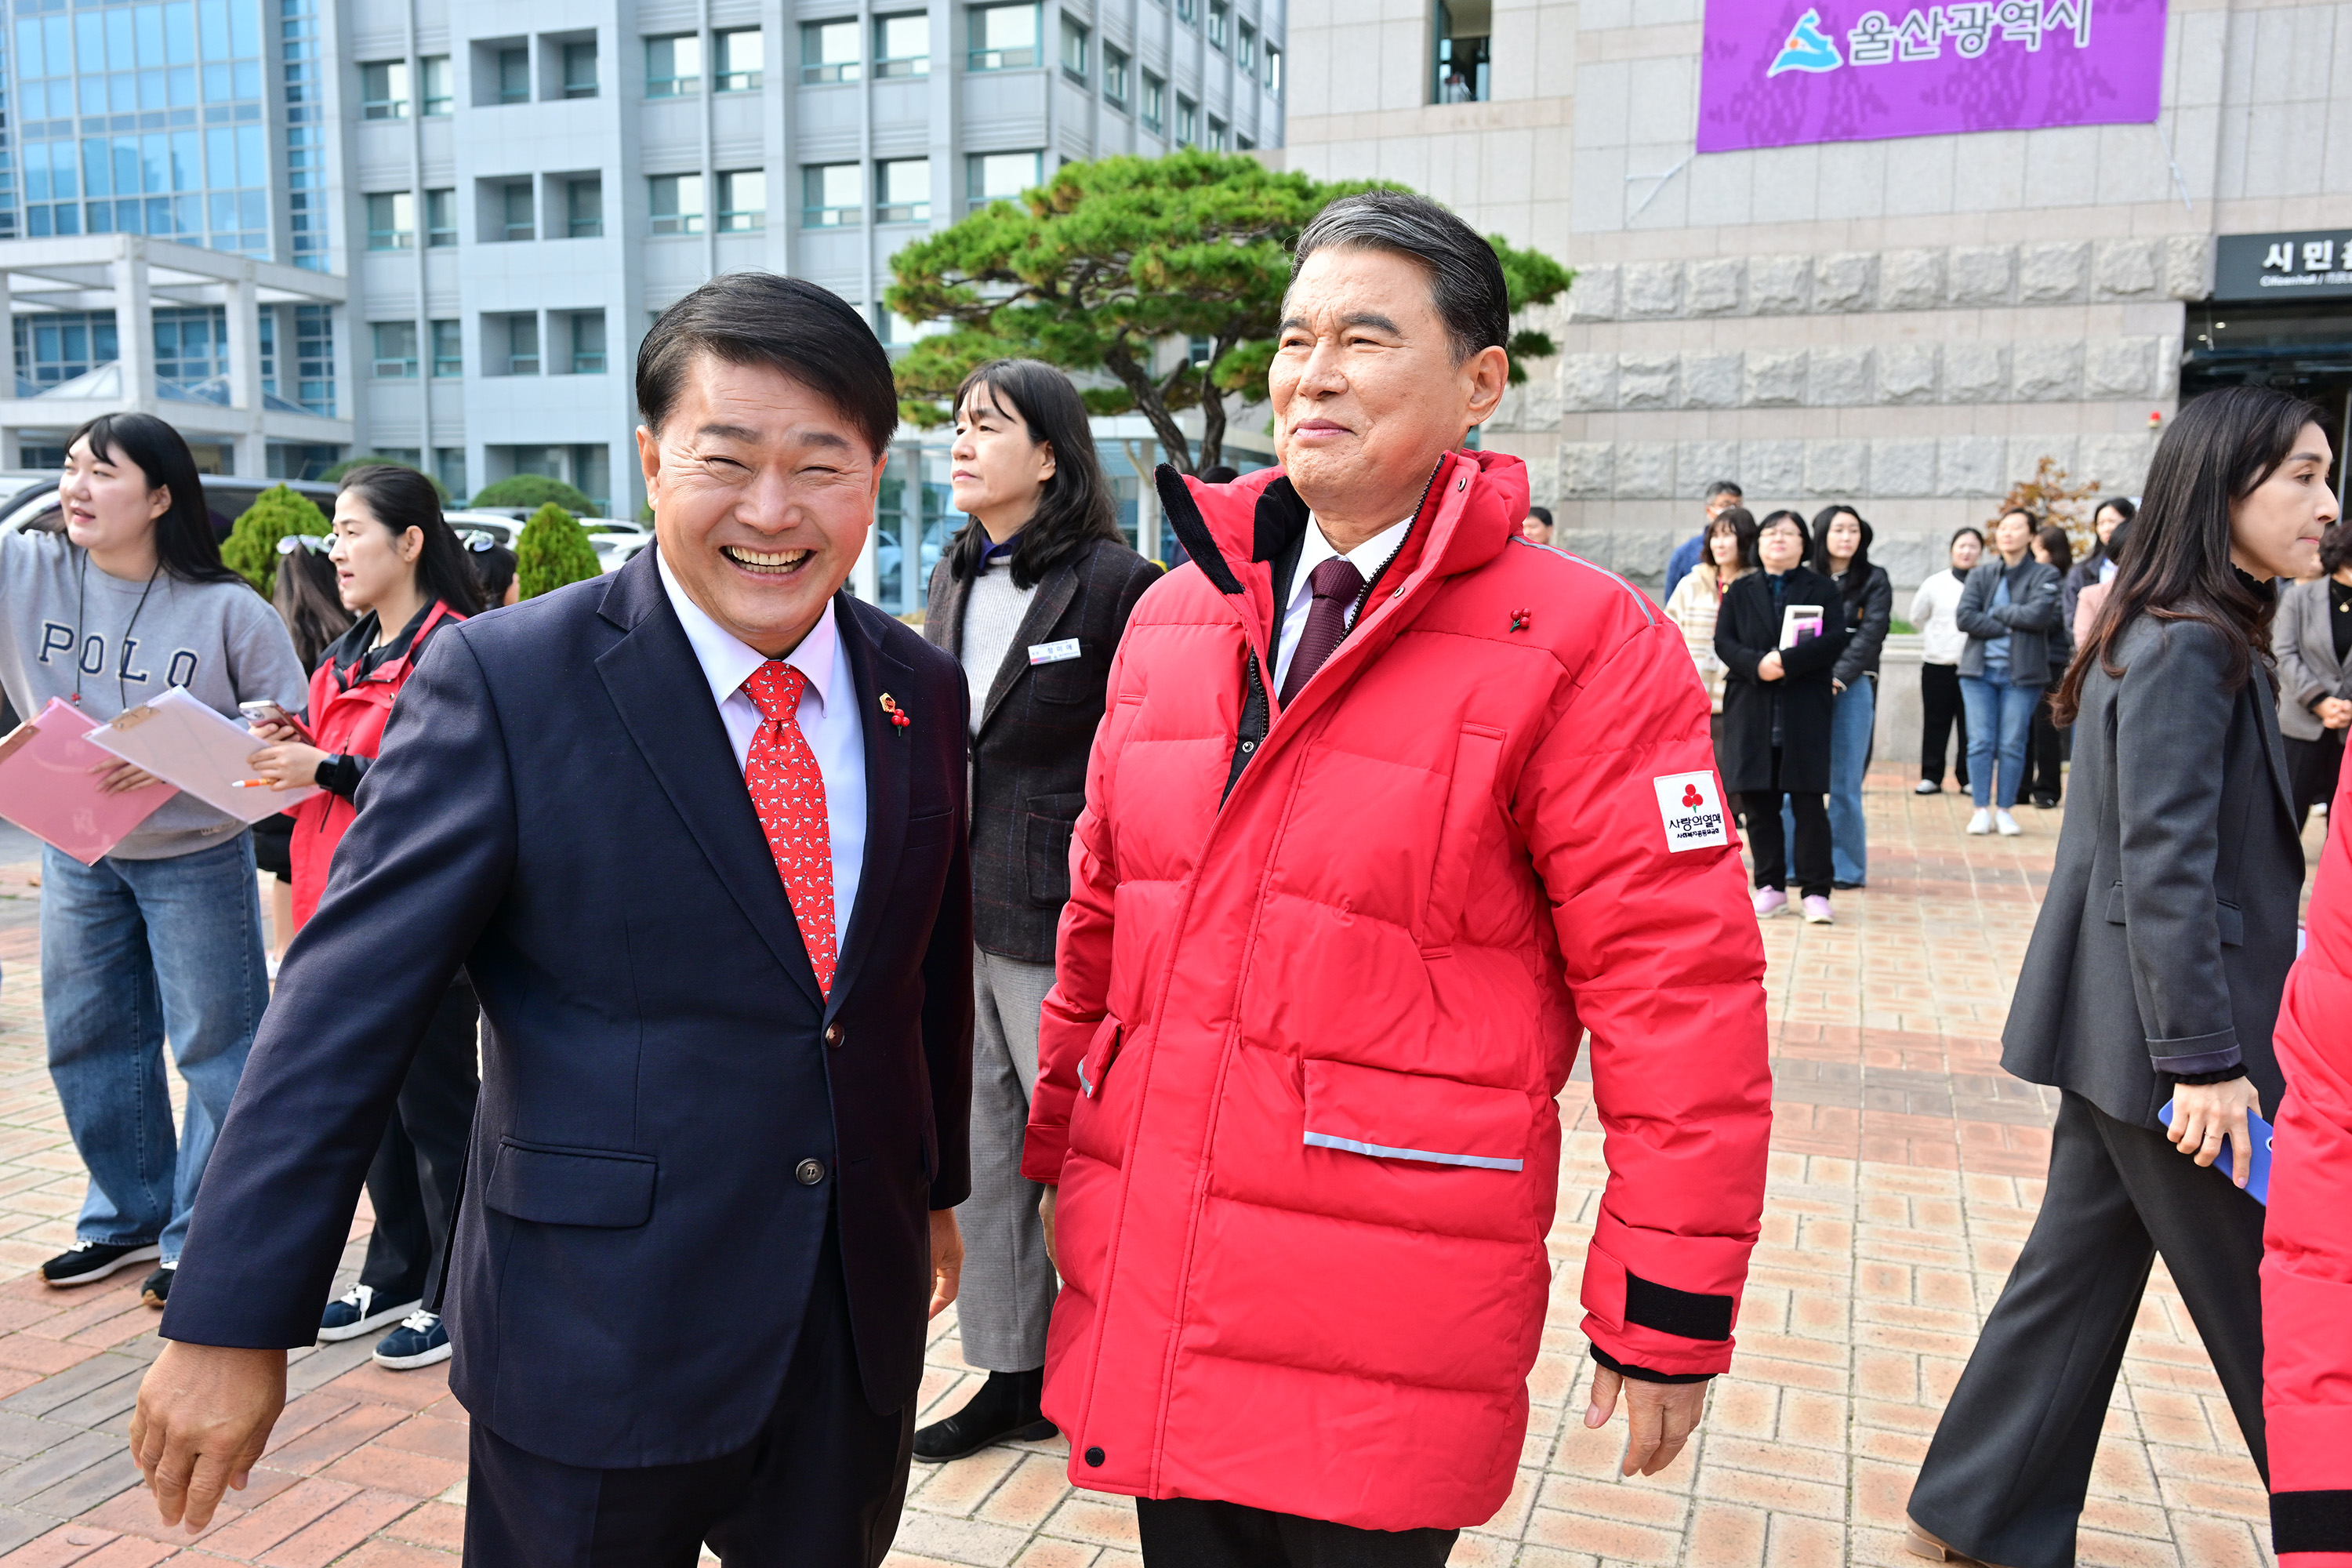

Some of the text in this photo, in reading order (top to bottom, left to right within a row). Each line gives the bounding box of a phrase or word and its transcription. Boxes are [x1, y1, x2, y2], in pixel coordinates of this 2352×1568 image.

[1847, 0, 2092, 66] 울산광역시
[38, 619, 200, 690] POLO
[1669, 813, 1722, 831] 사랑의열매
